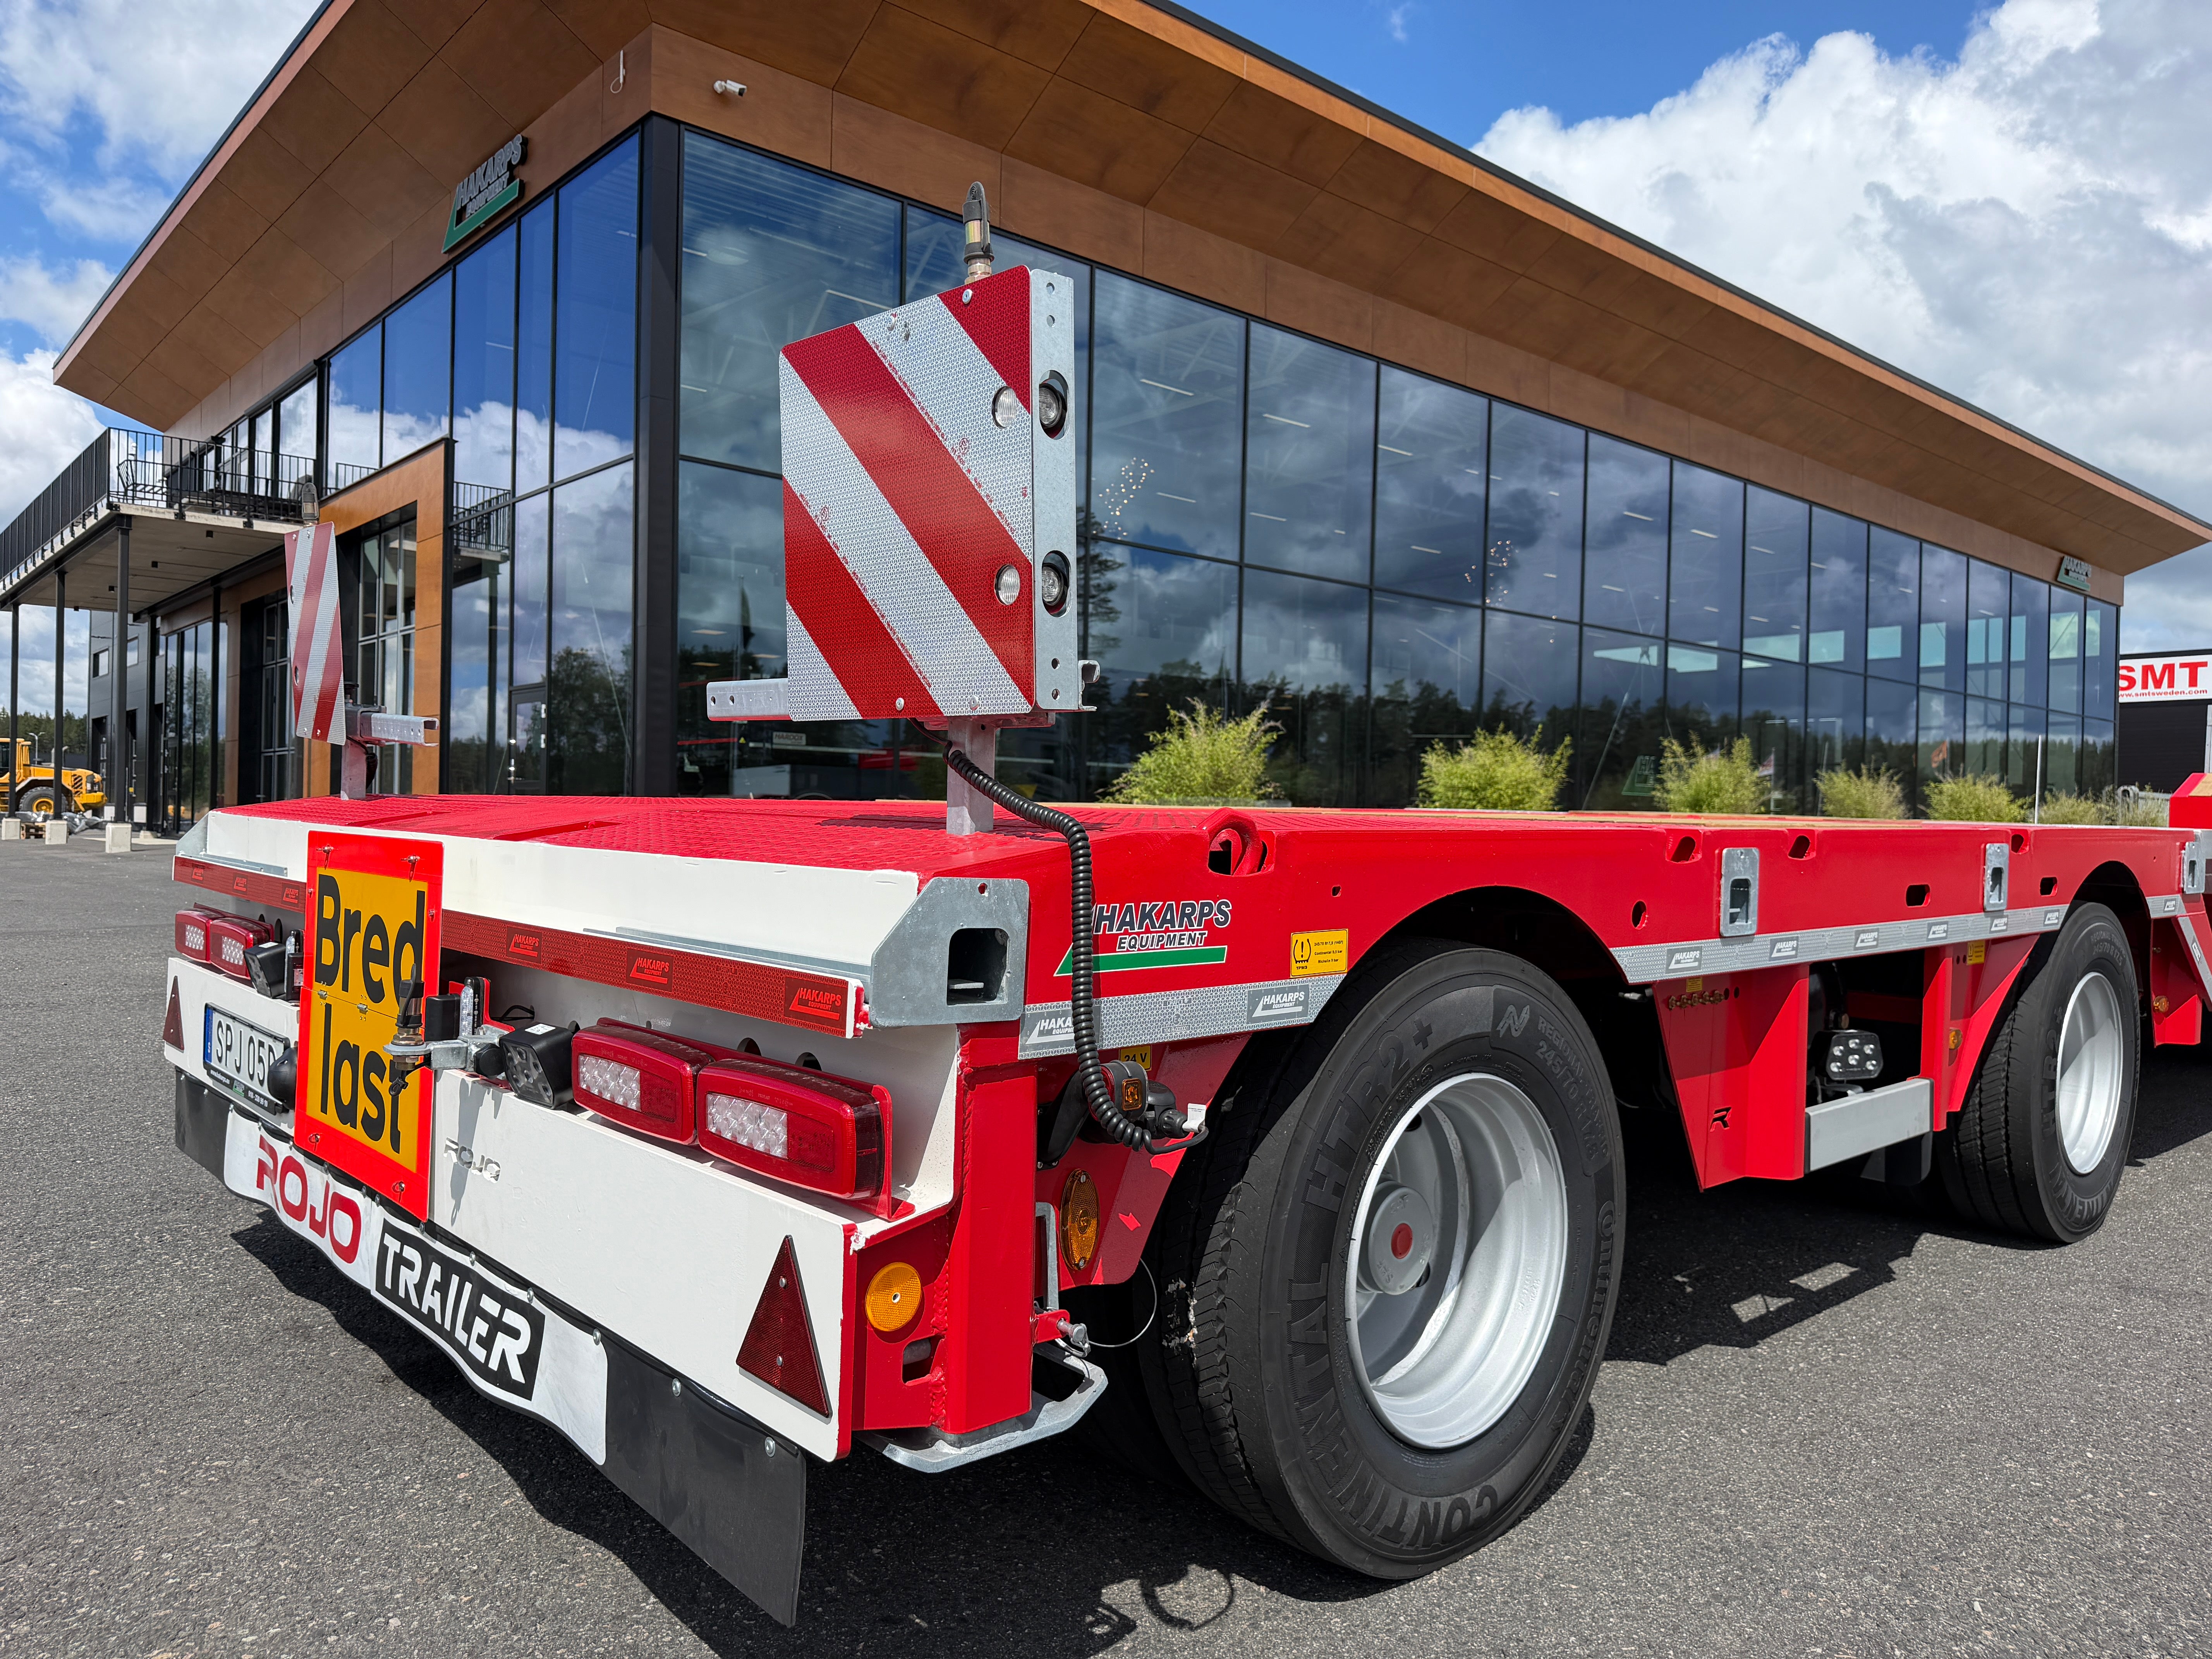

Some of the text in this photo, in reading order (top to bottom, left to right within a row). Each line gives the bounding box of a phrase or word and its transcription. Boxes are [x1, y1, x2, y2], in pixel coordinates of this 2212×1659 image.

[456, 134, 522, 211] HAKARPS
[465, 171, 510, 218] EQUIPMENT
[2119, 661, 2208, 691] SMT
[2119, 689, 2208, 698] ww.smtsweden.com
[1093, 899, 1232, 934] HAKARPS
[314, 873, 425, 1008] Bred
[515, 934, 539, 946] HAKARPS
[1116, 931, 1208, 951] EQUIPMENT
[1675, 951, 1700, 960] HAKARPS
[637, 957, 670, 972] HAKARPS
[799, 988, 842, 1006] HAKARPS
[1263, 992, 1305, 1005] HAKARPS
[1040, 1017, 1073, 1030] HAKA
[216, 1020, 242, 1074] SPJ
[1140, 1052, 1147, 1063] V
[1537, 1015, 1584, 1078] REGIONAL
[321, 1003, 401, 1154] last
[443, 1137, 501, 1184] ROJO
[256, 1134, 361, 1264] ROJO
[382, 1233, 532, 1384] TRAILER
[1288, 1262, 1498, 1549] CONTINENTAL
